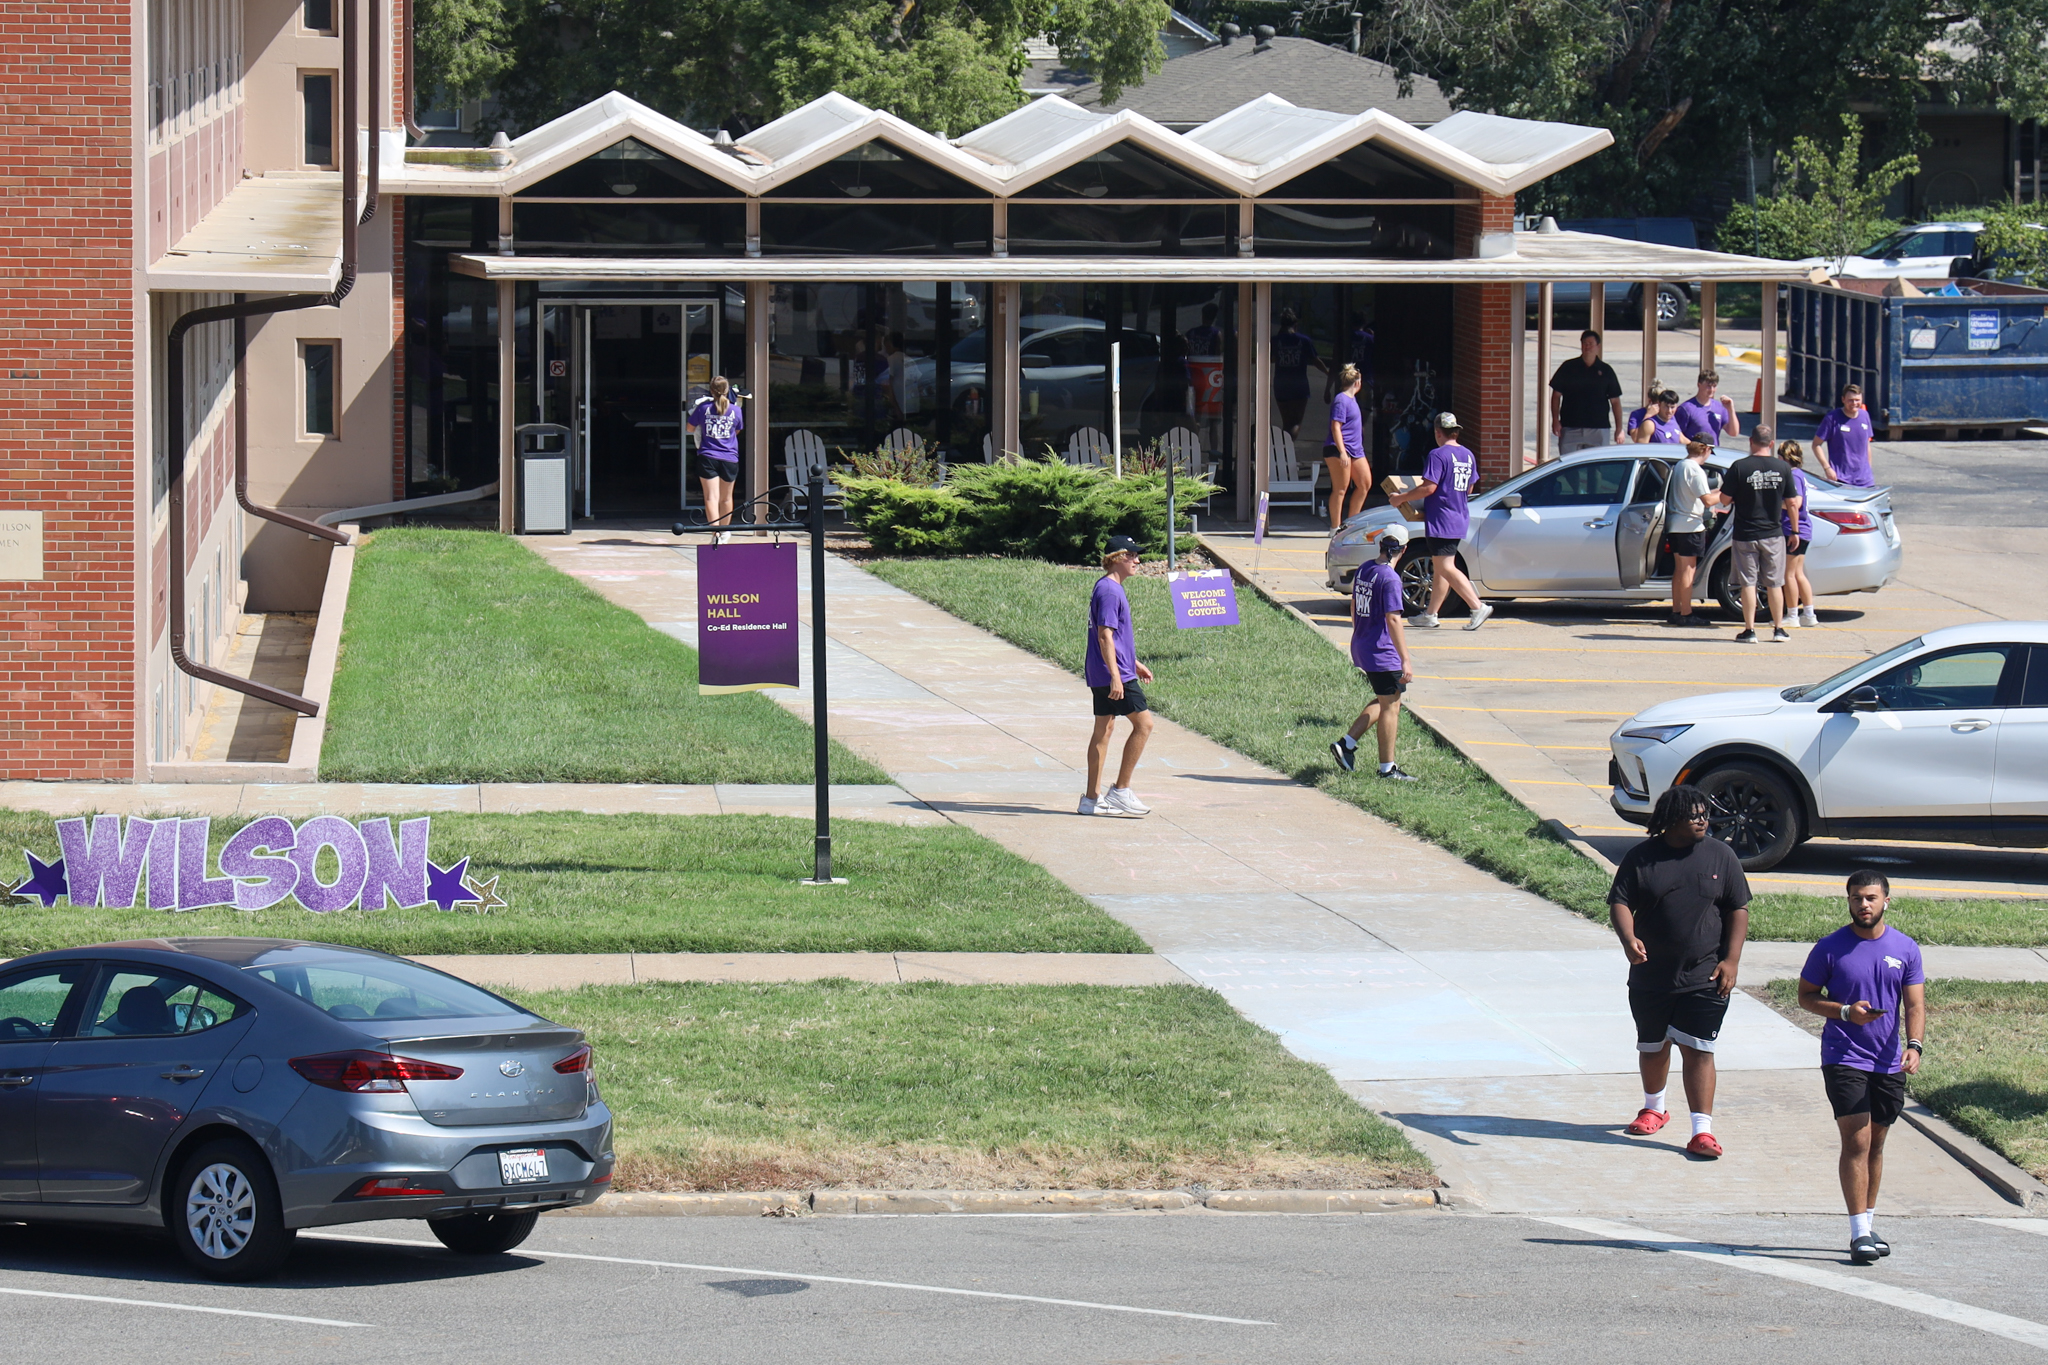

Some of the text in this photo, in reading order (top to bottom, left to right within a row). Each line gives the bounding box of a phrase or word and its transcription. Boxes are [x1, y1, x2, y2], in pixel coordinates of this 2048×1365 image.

[706, 423, 732, 437] PACK
[0, 523, 31, 531] ILSON
[707, 593, 760, 604] WILSON
[1180, 589, 1226, 600] WELCOME
[1190, 598, 1220, 608] HOME,
[707, 608, 742, 619] HALL
[1187, 606, 1227, 617] COYOTES
[707, 622, 787, 632] Co-Ed Residence Hall
[54, 813, 431, 913] WILSON
[471, 1089, 555, 1098] ELANTRA
[503, 1160, 545, 1179] 8XCM647
